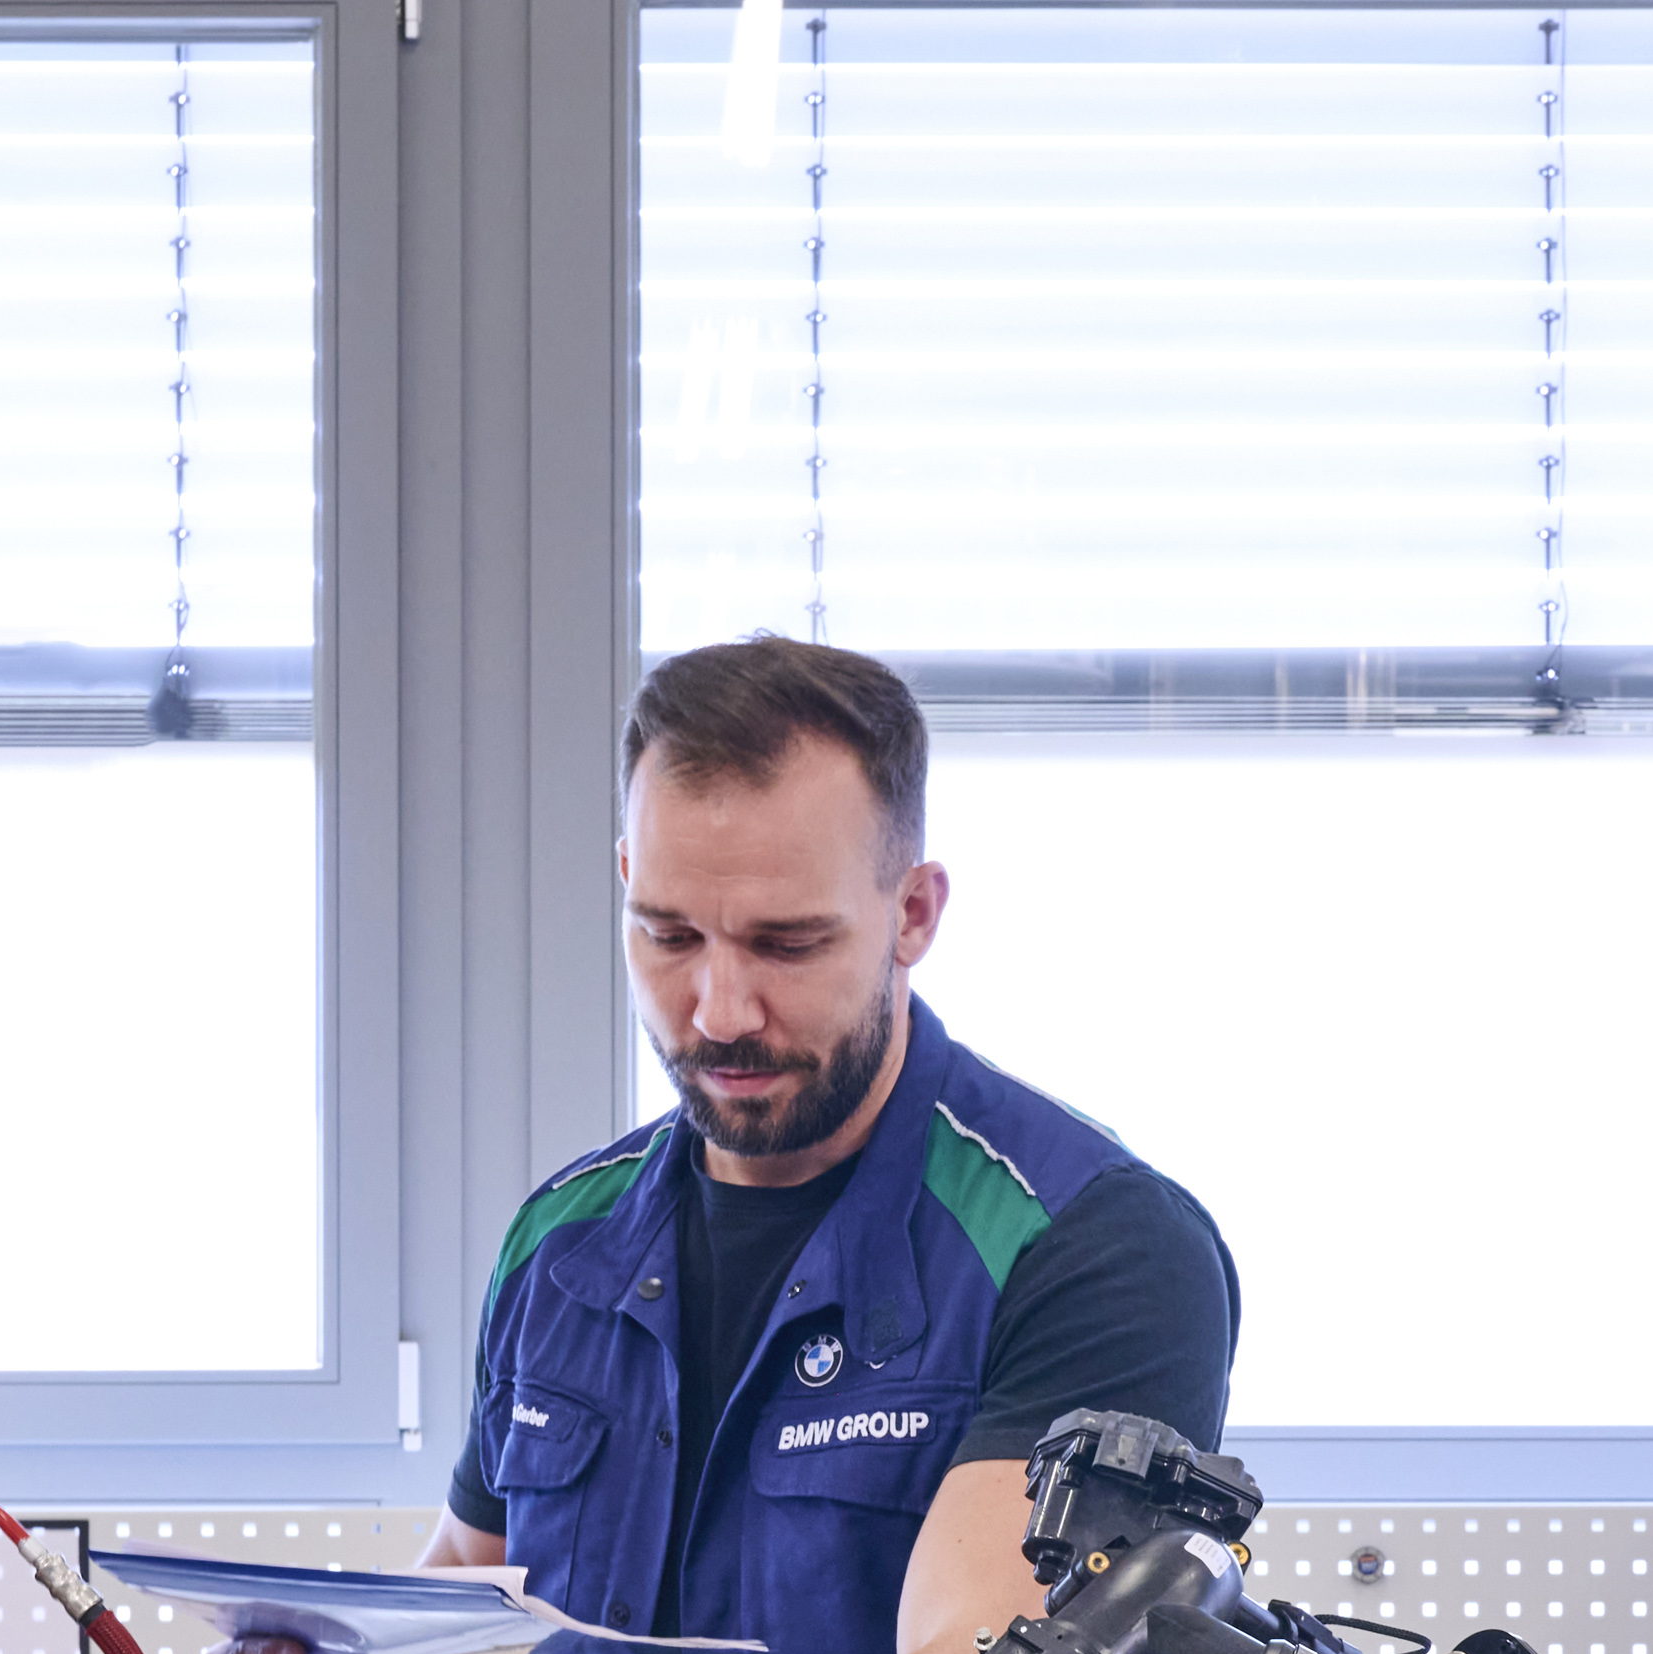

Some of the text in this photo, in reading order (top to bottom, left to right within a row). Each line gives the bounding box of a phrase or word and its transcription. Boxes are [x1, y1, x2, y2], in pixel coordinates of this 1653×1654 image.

[516, 1403, 549, 1427] Gerber
[778, 1411, 929, 1450] BMW GROUP
